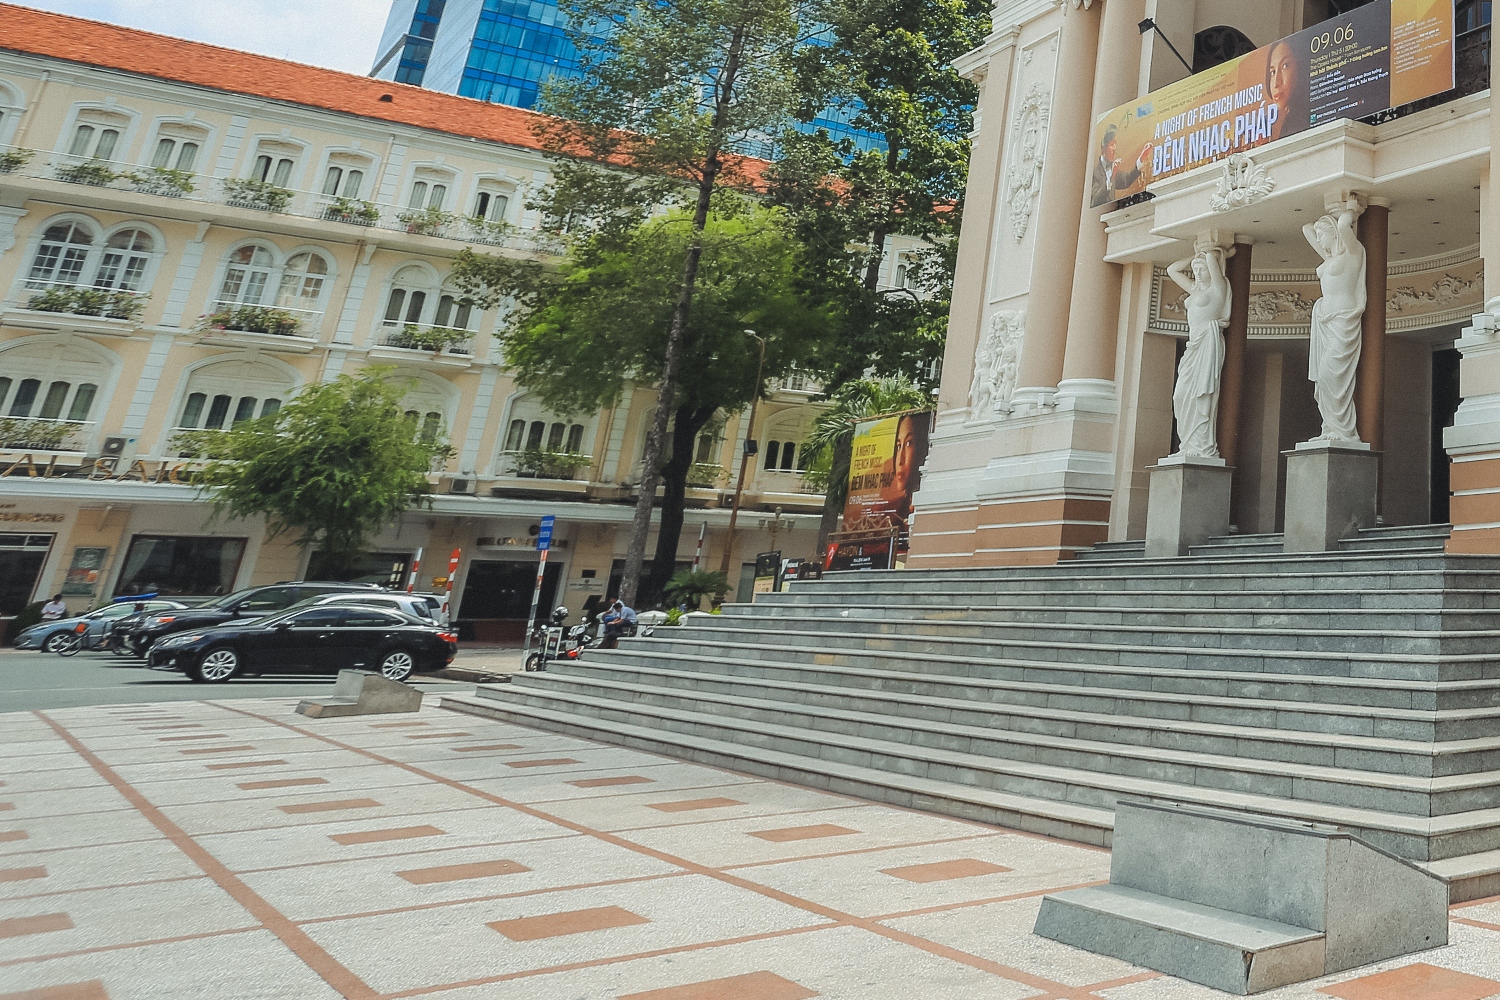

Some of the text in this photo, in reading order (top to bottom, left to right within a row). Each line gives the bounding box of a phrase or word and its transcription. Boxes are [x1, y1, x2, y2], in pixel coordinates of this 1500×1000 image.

[1310, 22, 1354, 54] 09.06
[1154, 123, 1160, 140] A
[1161, 112, 1186, 138] NIGHT
[1187, 107, 1199, 127] OF
[1199, 94, 1233, 123] FRENCH
[1234, 83, 1263, 110] MUSIC
[1152, 100, 1279, 177] ĐÊM NHẠC PHÁP
[0, 452, 66, 479] AL
